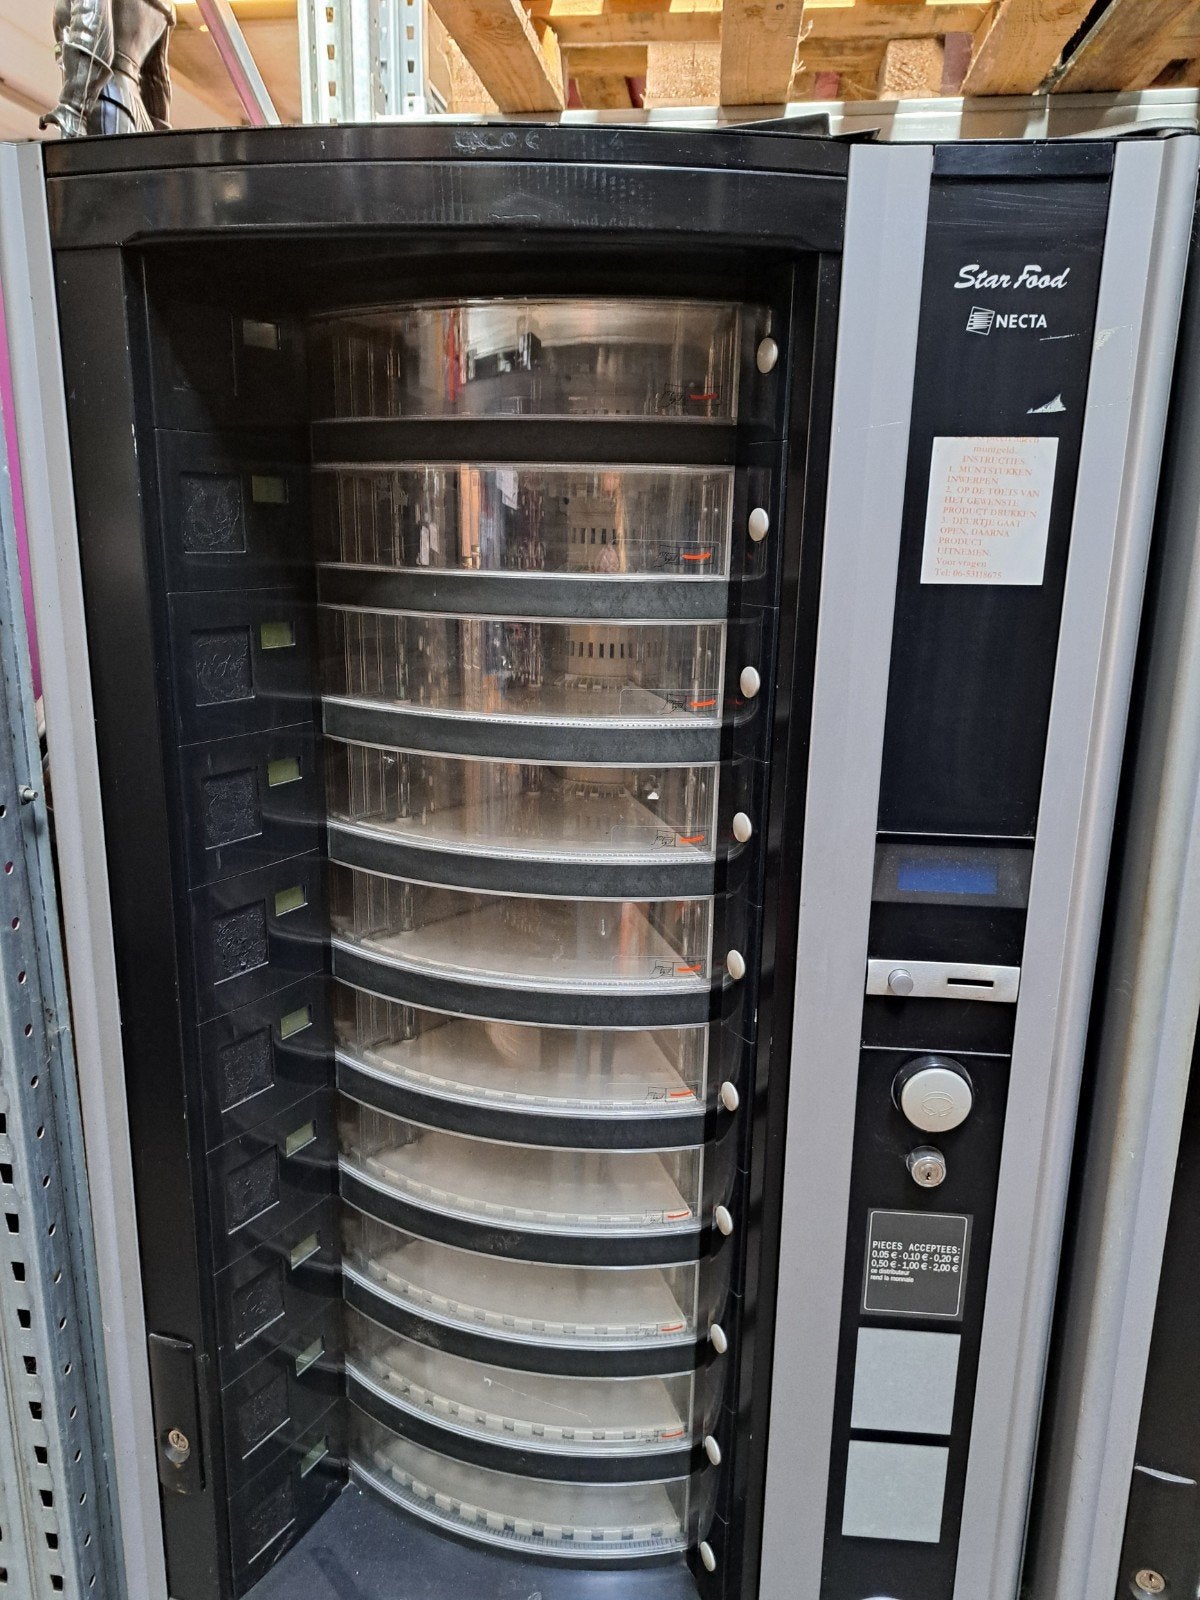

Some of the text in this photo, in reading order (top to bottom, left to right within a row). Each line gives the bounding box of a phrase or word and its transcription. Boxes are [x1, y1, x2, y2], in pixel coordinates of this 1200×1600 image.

[953, 263, 1071, 289] Star Food
[995, 313, 1048, 329] NECTA
[946, 475, 999, 485] INWERPEN
[956, 486, 970, 494] OP
[972, 487, 985, 495] DE
[988, 487, 1018, 497] TOETS
[1020, 489, 1040, 498] VAN
[944, 496, 964, 505] HET
[943, 506, 1037, 518] PRODUCT DRUKKEN
[996, 519, 1022, 528] GAAT
[971, 528, 1010, 538] DAARNA
[938, 536, 982, 546] PRODUCT
[936, 557, 987, 569] Voor vragen
[872, 1240, 961, 1254] PIECES ACCEPTEES:
[890, 1251, 898, 1259] €
[921, 1253, 929, 1261] €
[953, 1255, 960, 1264] €
[878, 1268, 910, 1276] distributeur
[890, 1260, 897, 1268] €
[921, 1262, 928, 1271] €
[952, 1264, 959, 1273] €
